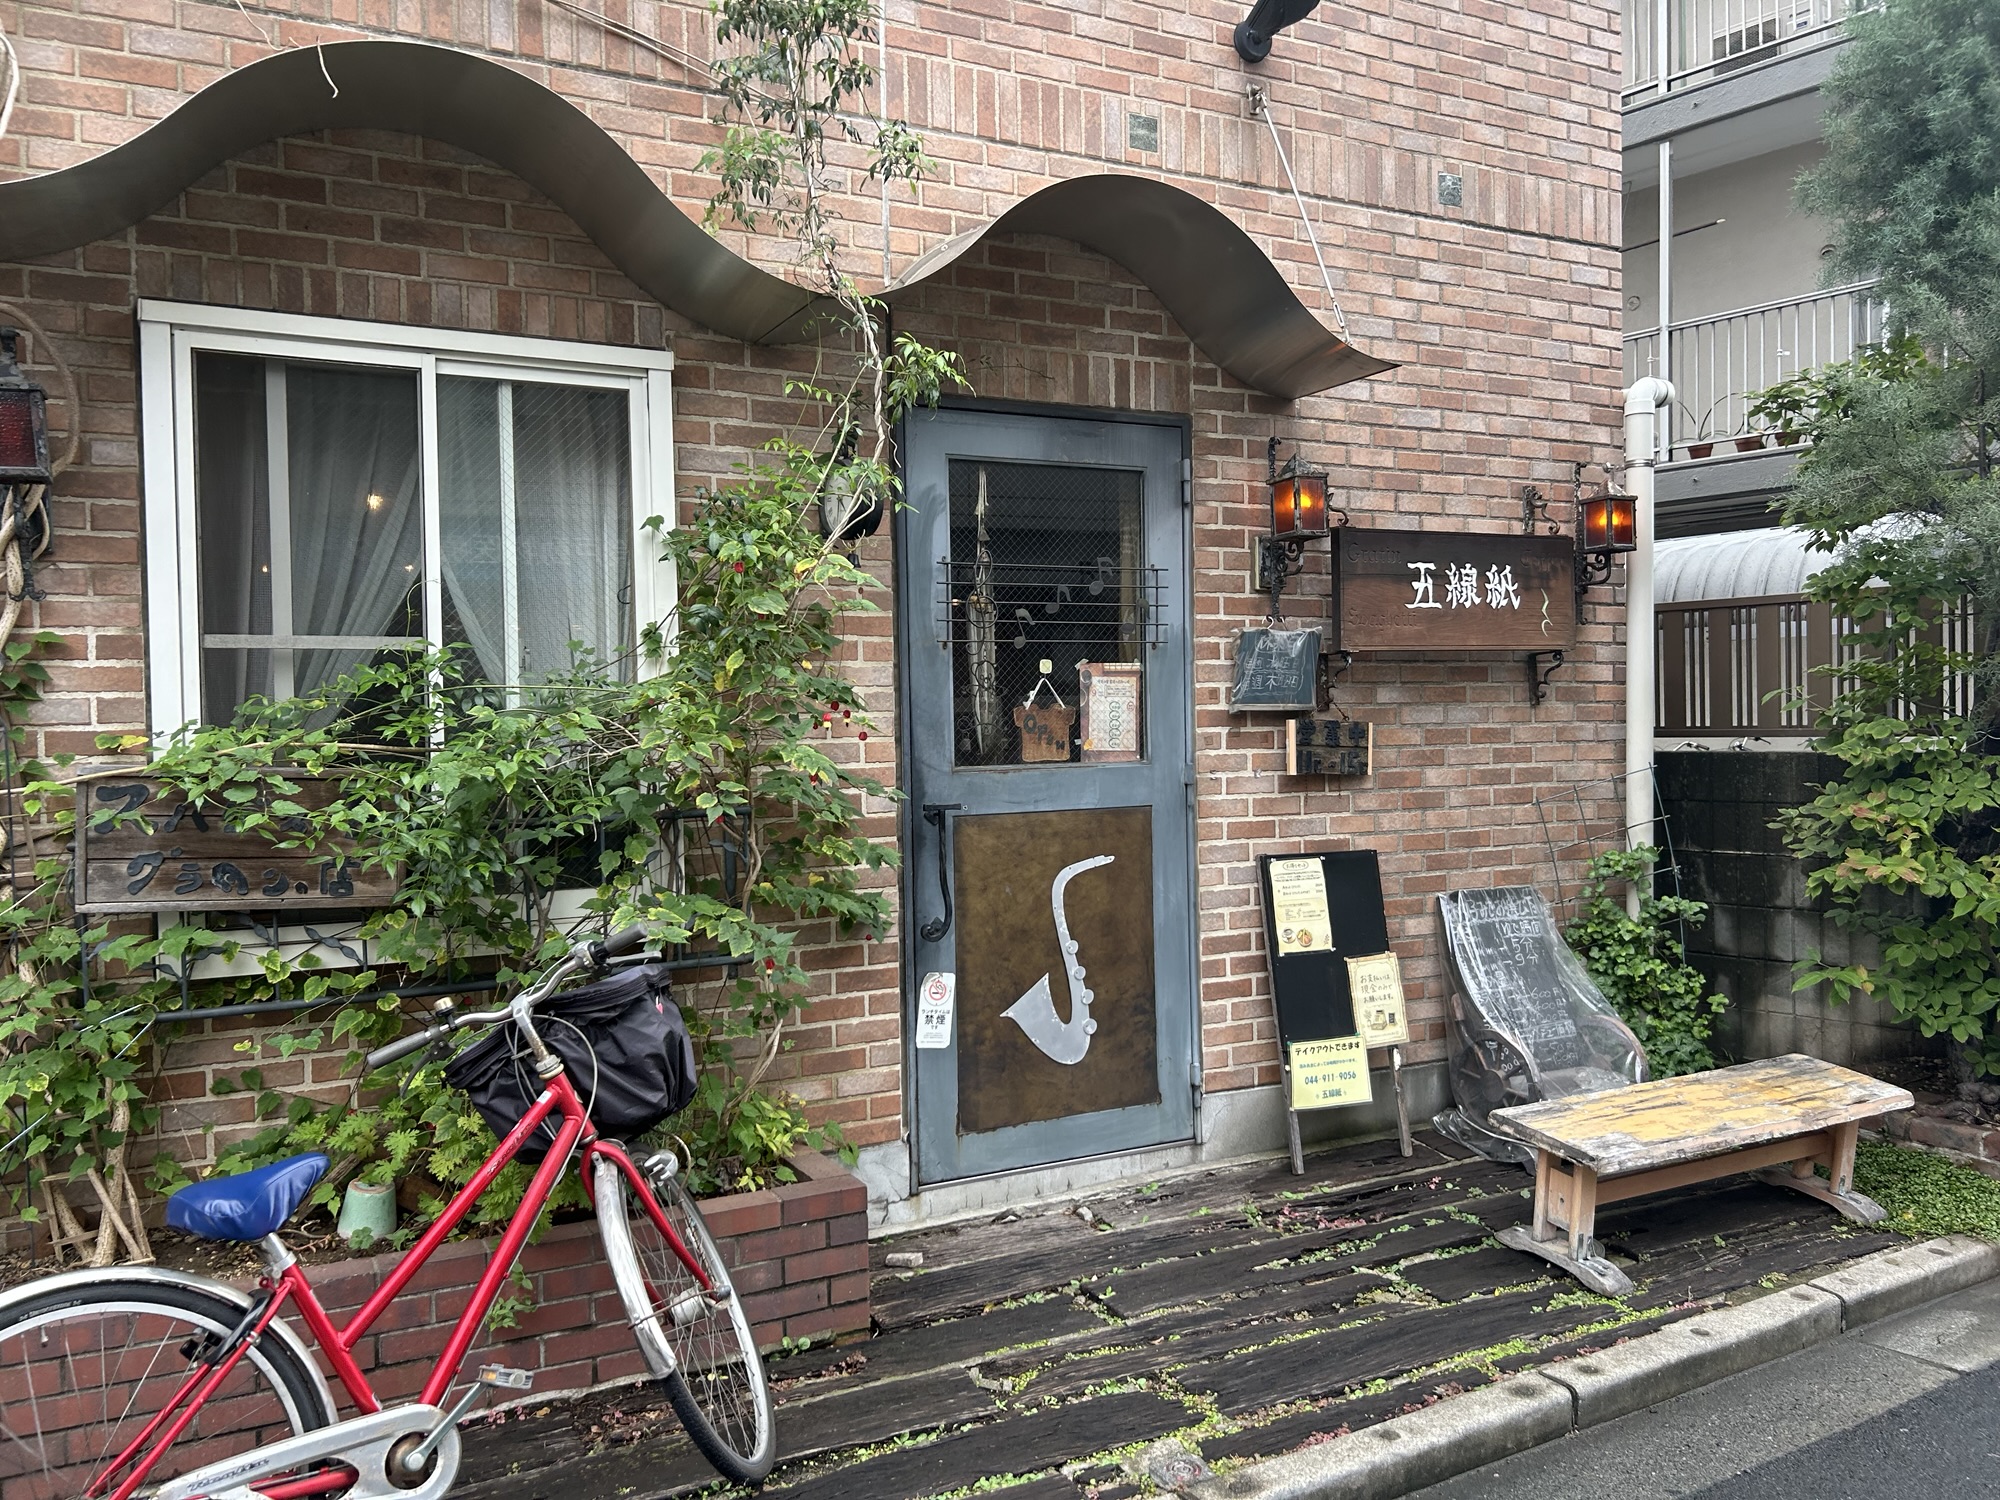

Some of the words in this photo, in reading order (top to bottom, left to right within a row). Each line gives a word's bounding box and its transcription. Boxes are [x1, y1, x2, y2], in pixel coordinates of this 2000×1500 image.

[1404, 561, 1521, 611] 五線紙
[1347, 608, 1419, 632] Spaghetti
[1514, 953, 1539, 967] 9分
[1360, 973, 1390, 983] お支払いは
[1361, 984, 1393, 994] 現金のみで
[1363, 995, 1394, 1004] お願いします。
[924, 1014, 946, 1025] 禁煙
[1295, 1041, 1360, 1056] テイクアウトできます
[1304, 1071, 1357, 1085] 044-911-9056
